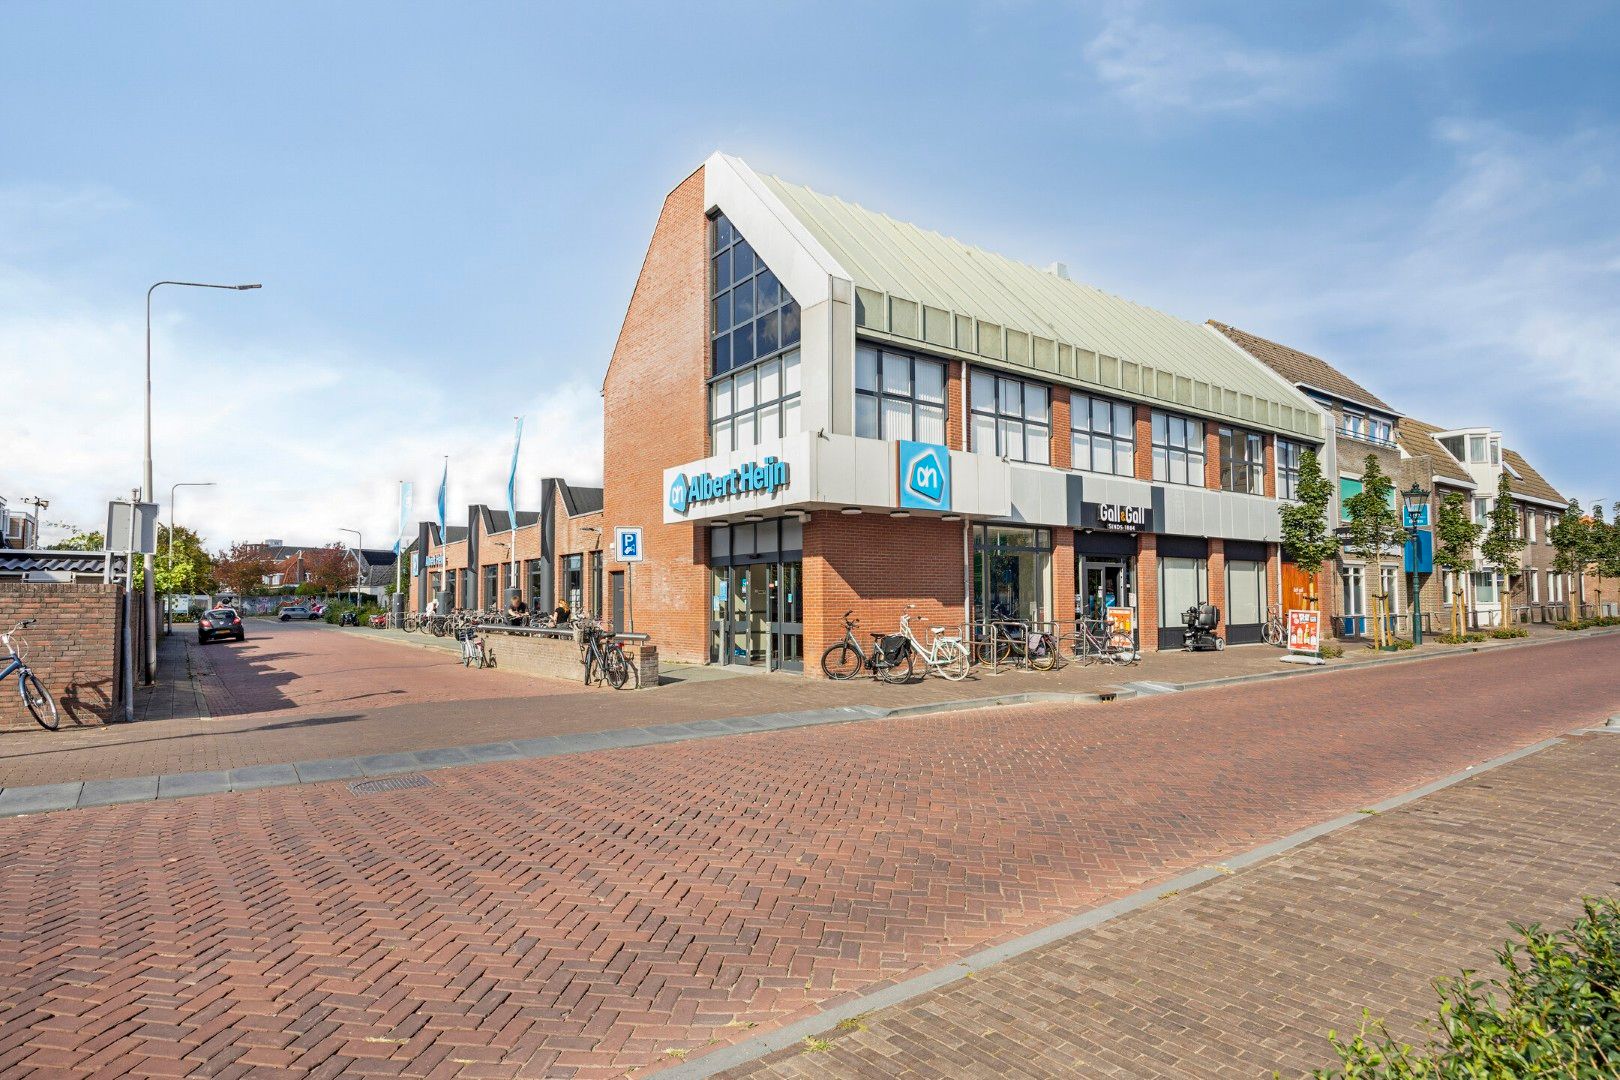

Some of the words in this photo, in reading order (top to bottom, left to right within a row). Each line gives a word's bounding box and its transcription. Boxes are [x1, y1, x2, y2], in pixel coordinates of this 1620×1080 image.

[688, 468, 738, 503] Albert
[740, 456, 788, 494] Heijn
[624, 534, 634, 547] P
